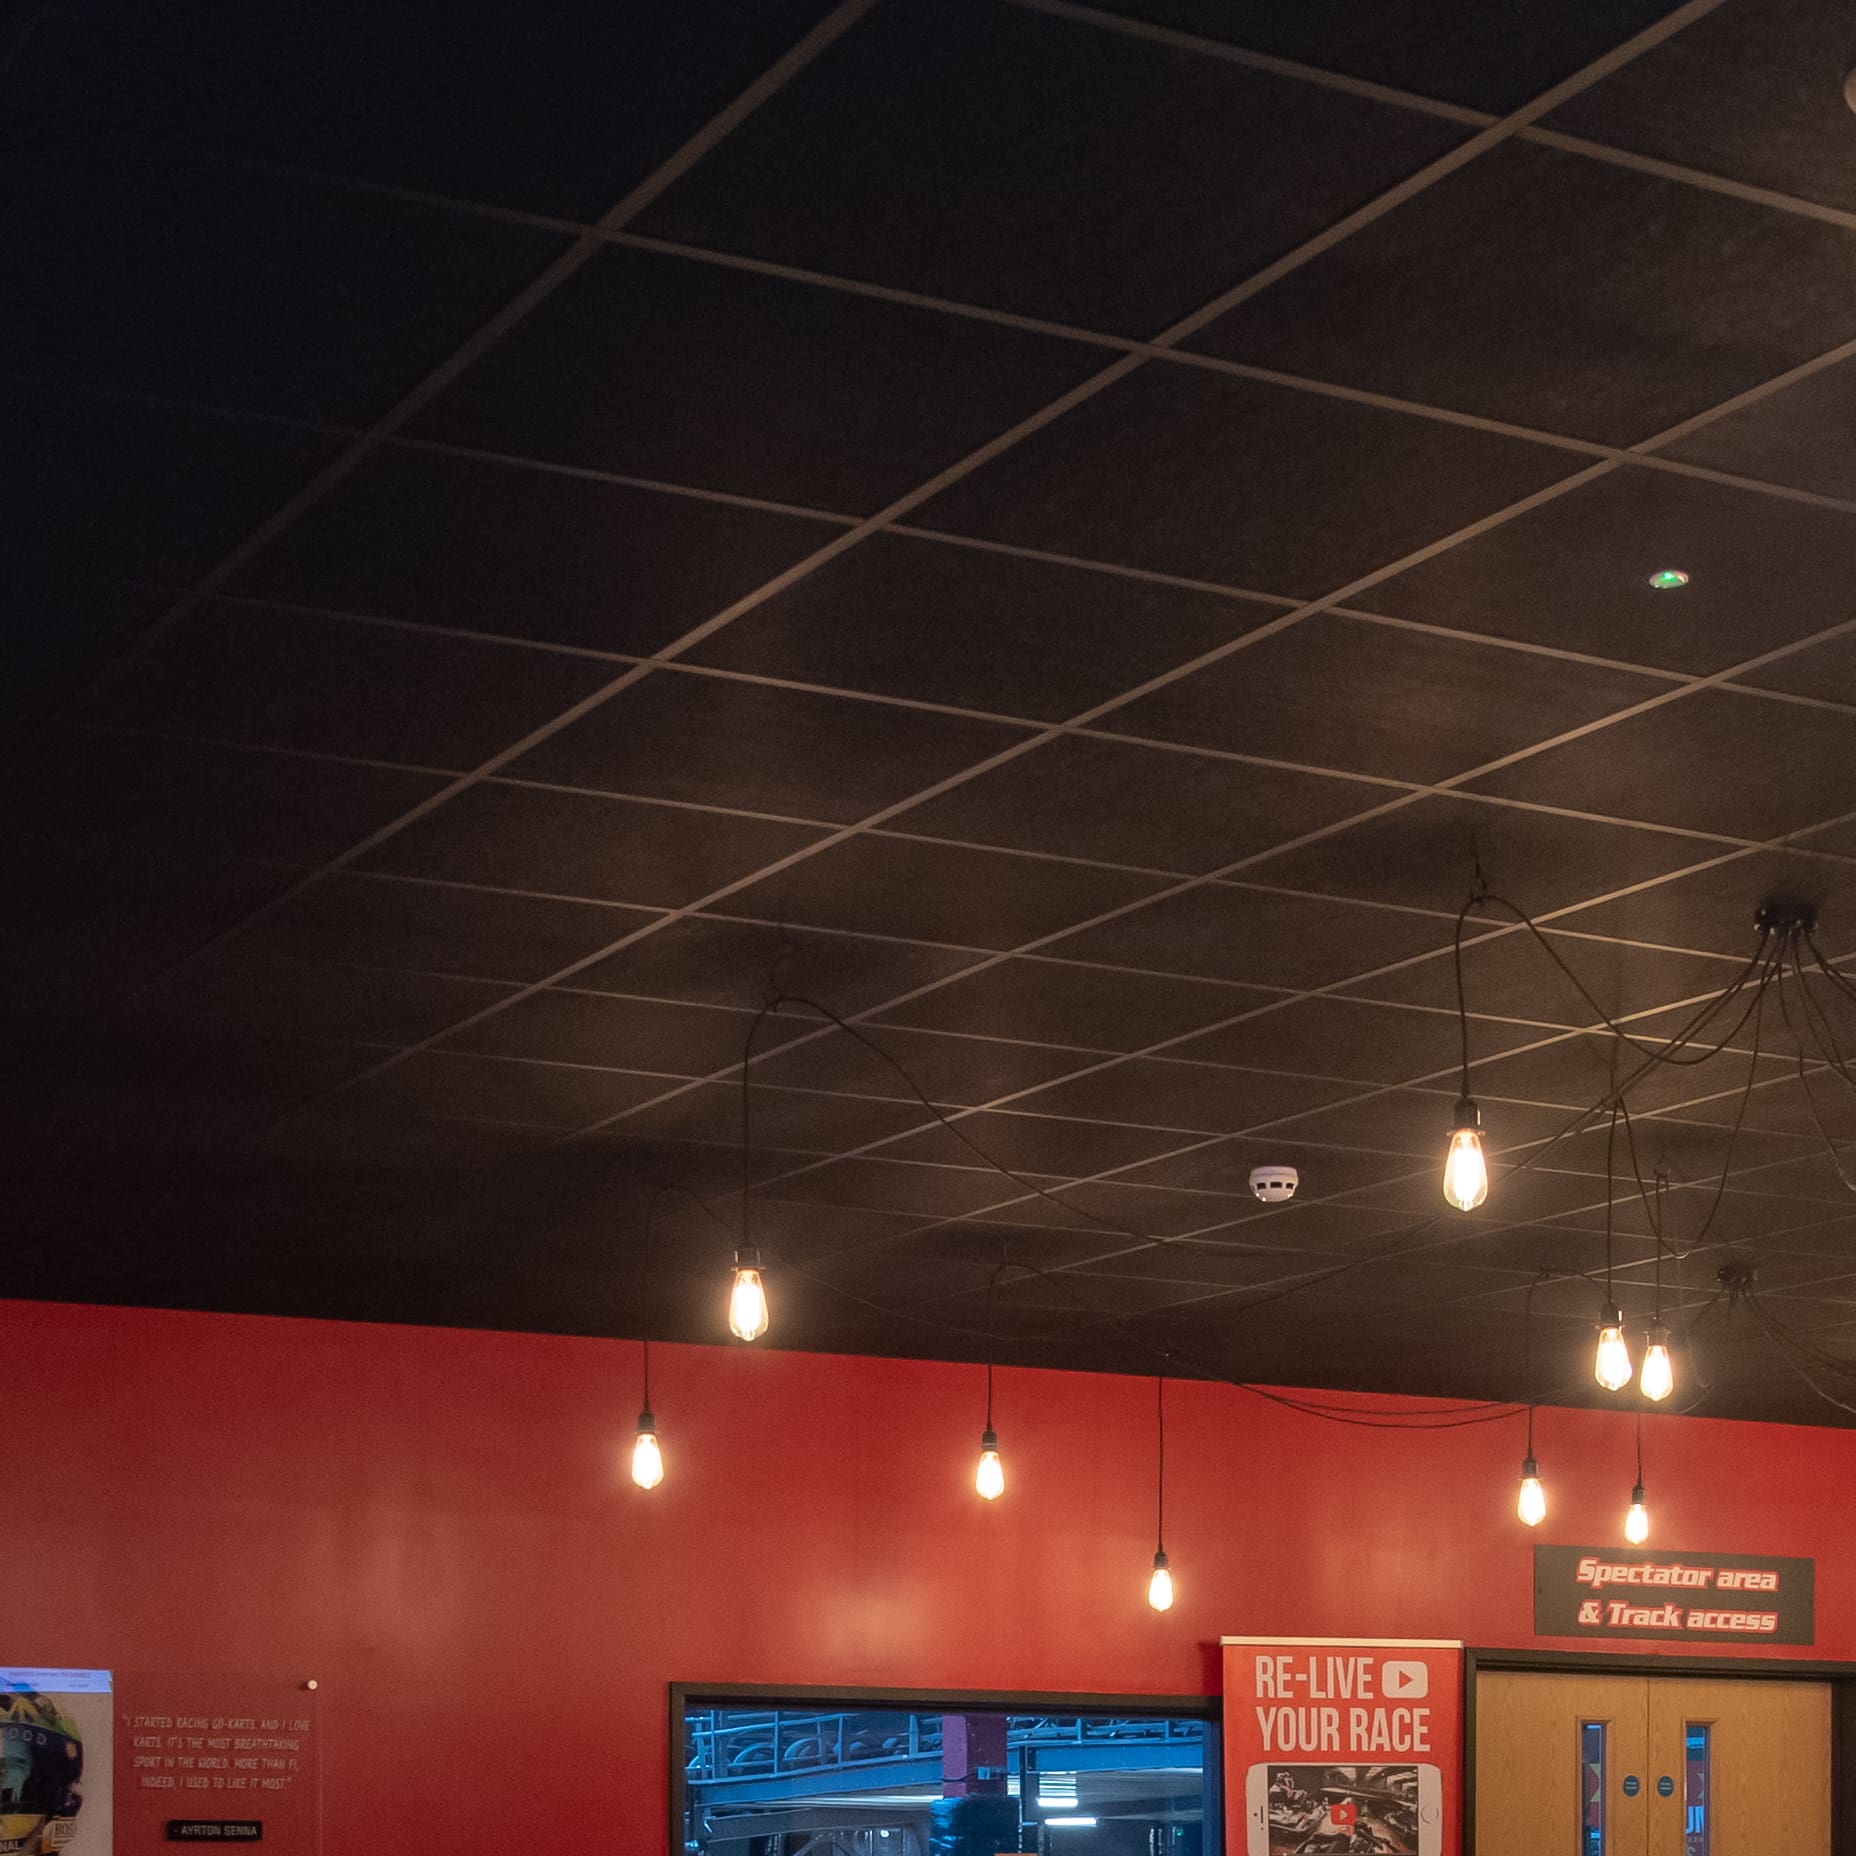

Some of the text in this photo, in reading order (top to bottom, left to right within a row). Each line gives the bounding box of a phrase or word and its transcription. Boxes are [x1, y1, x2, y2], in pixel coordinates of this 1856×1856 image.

[1576, 1557, 1779, 1592] Spectator area
[1578, 1601, 1778, 1633] & Track access
[1255, 1655, 1375, 1699] RE-LIVE
[133, 1716, 173, 1728] STARTED
[176, 1717, 209, 1729] RACING
[260, 1719, 279, 1730] AND
[288, 1719, 311, 1731] LOVE
[1255, 1706, 1431, 1752] YOUR RACE
[187, 1737, 204, 1749] THE
[208, 1738, 232, 1750] MOST
[234, 1738, 300, 1751] BREATHTAKING
[133, 1756, 161, 1768] SPORT
[164, 1756, 175, 1768] IN
[178, 1757, 195, 1768] THE
[235, 1758, 259, 1770] MORE
[262, 1758, 286, 1770] THAN
[186, 1777, 209, 1789] USED
[213, 1777, 224, 1789] TO
[227, 1778, 246, 1789] LIKE
[250, 1778, 259, 1789] IT
[181, 1825, 221, 1836] AYRTON
[224, 1825, 258, 1837] SENNA
